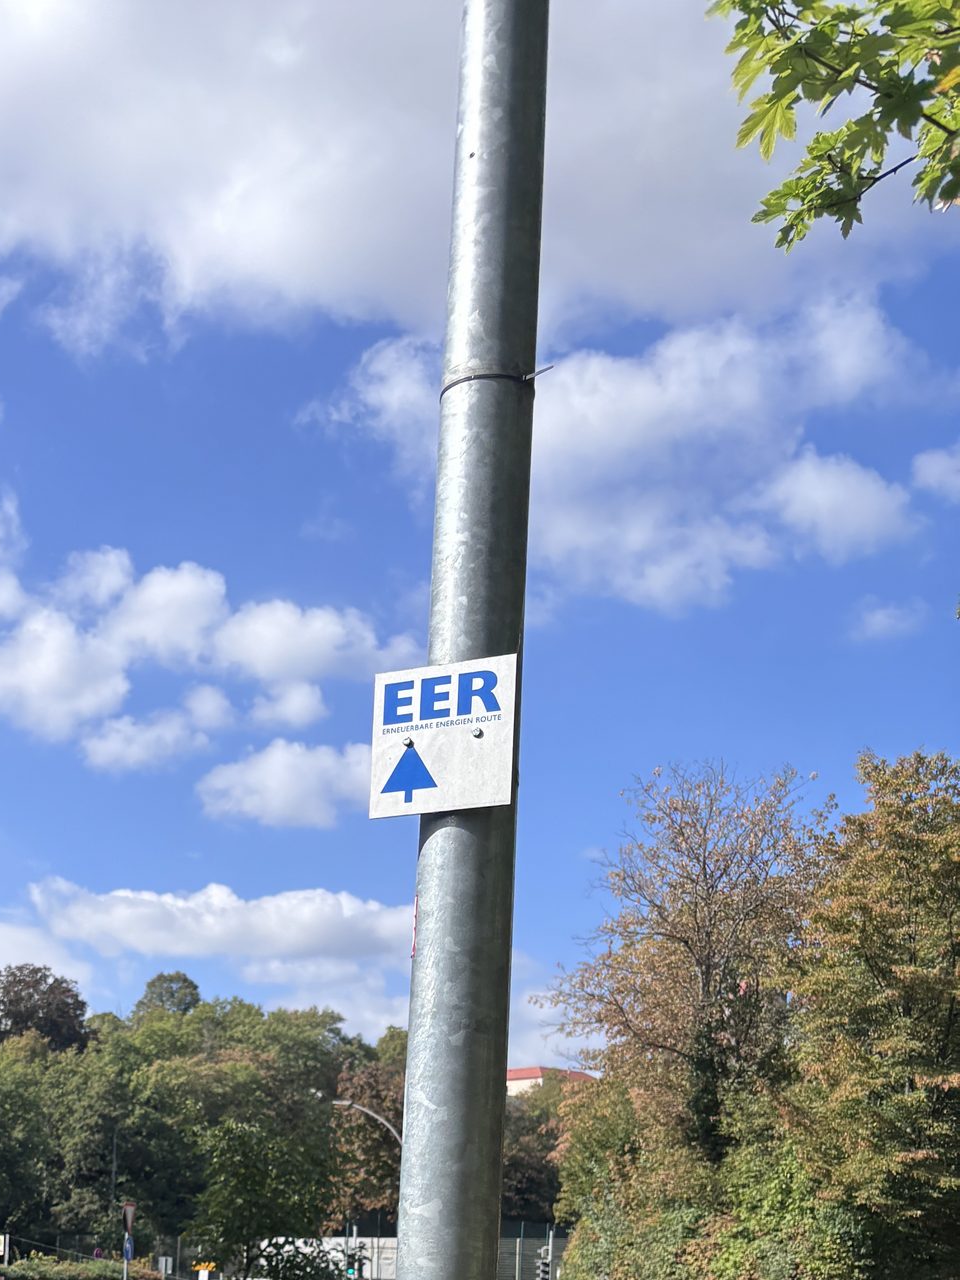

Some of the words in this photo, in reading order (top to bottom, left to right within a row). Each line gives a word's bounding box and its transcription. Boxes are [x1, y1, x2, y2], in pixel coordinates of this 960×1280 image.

[382, 670, 501, 726] EER
[382, 722, 434, 735] ERNEUERBARE
[435, 718, 474, 729] ENERGIEN
[475, 714, 502, 724] ROUTE
